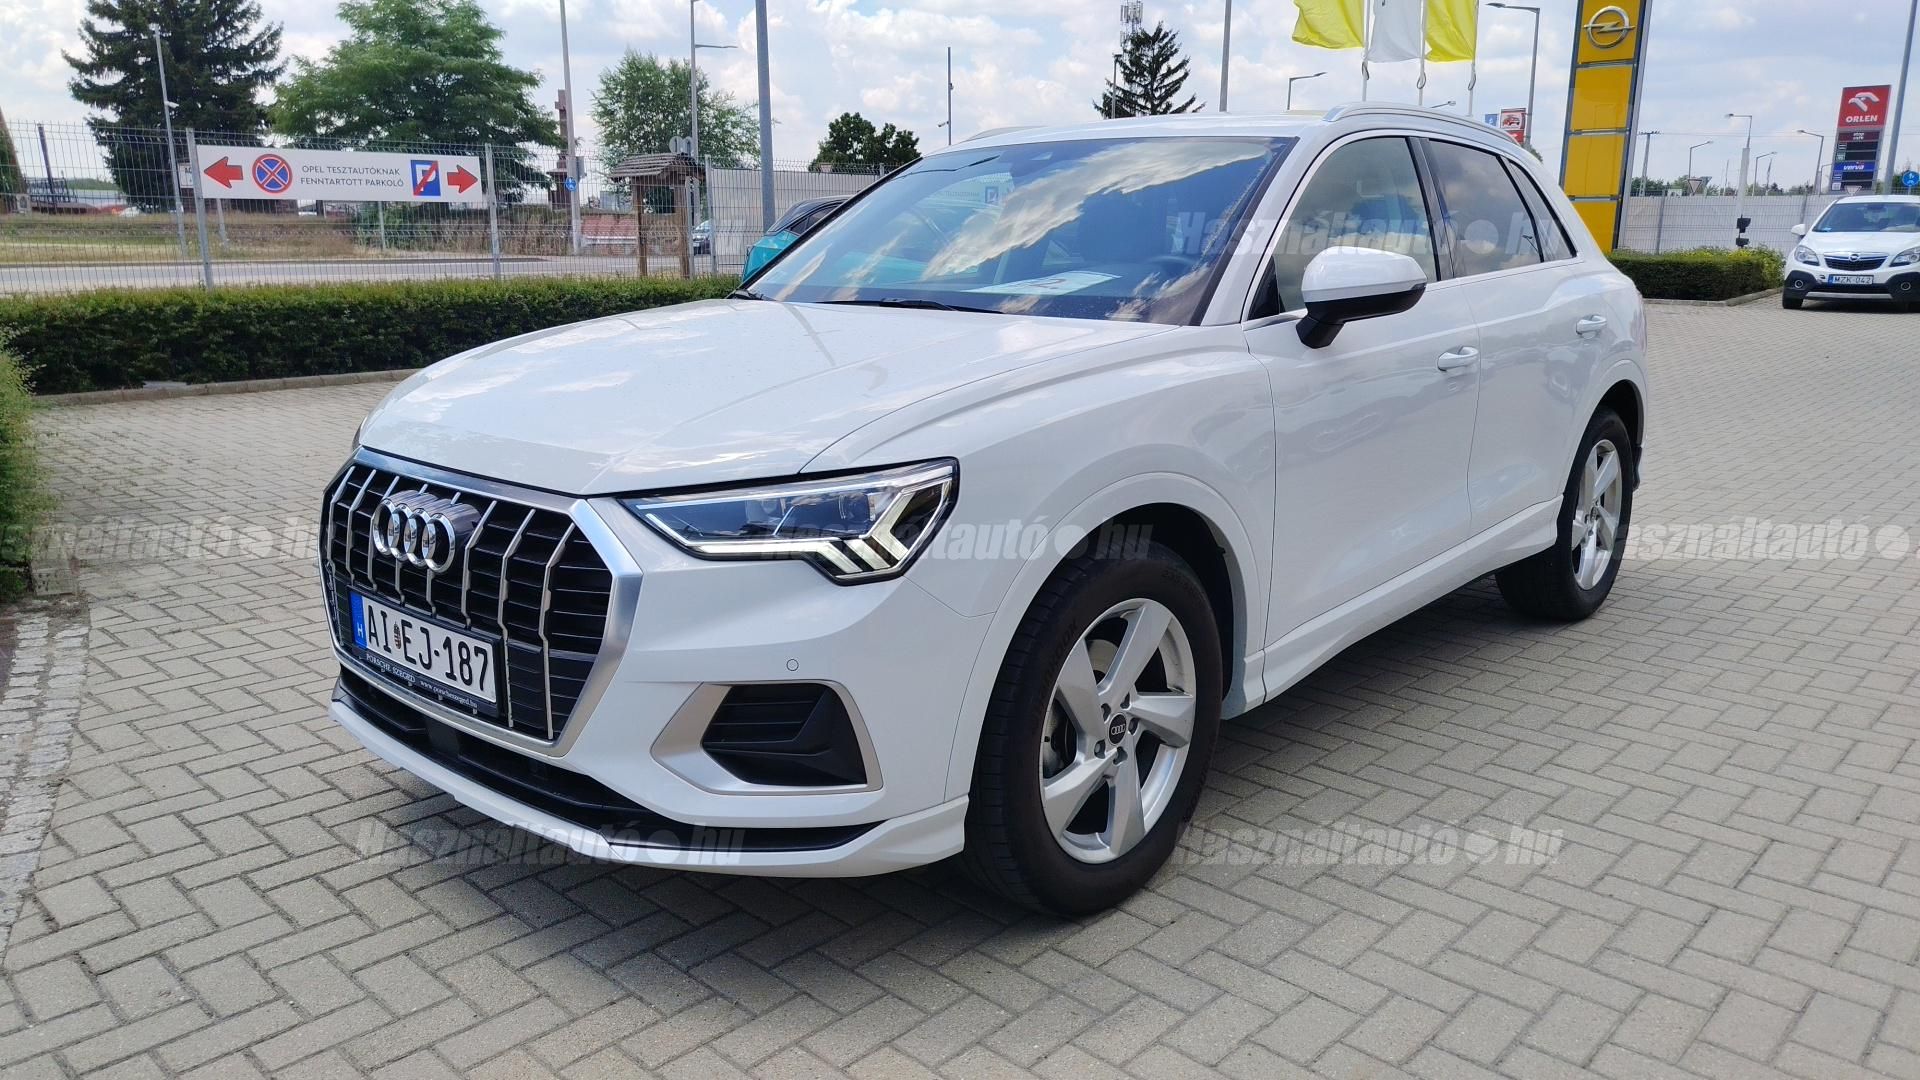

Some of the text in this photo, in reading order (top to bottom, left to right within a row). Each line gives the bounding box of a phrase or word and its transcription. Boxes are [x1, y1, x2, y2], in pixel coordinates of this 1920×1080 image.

[1845, 115, 1878, 123] ORLEN
[302, 164, 401, 176] OPEL TESZTAUTÓKNAK
[301, 176, 404, 188] FENNTARTOTT PARKOLÓ
[1834, 276, 1871, 284] MZK-042
[357, 622, 364, 638] H
